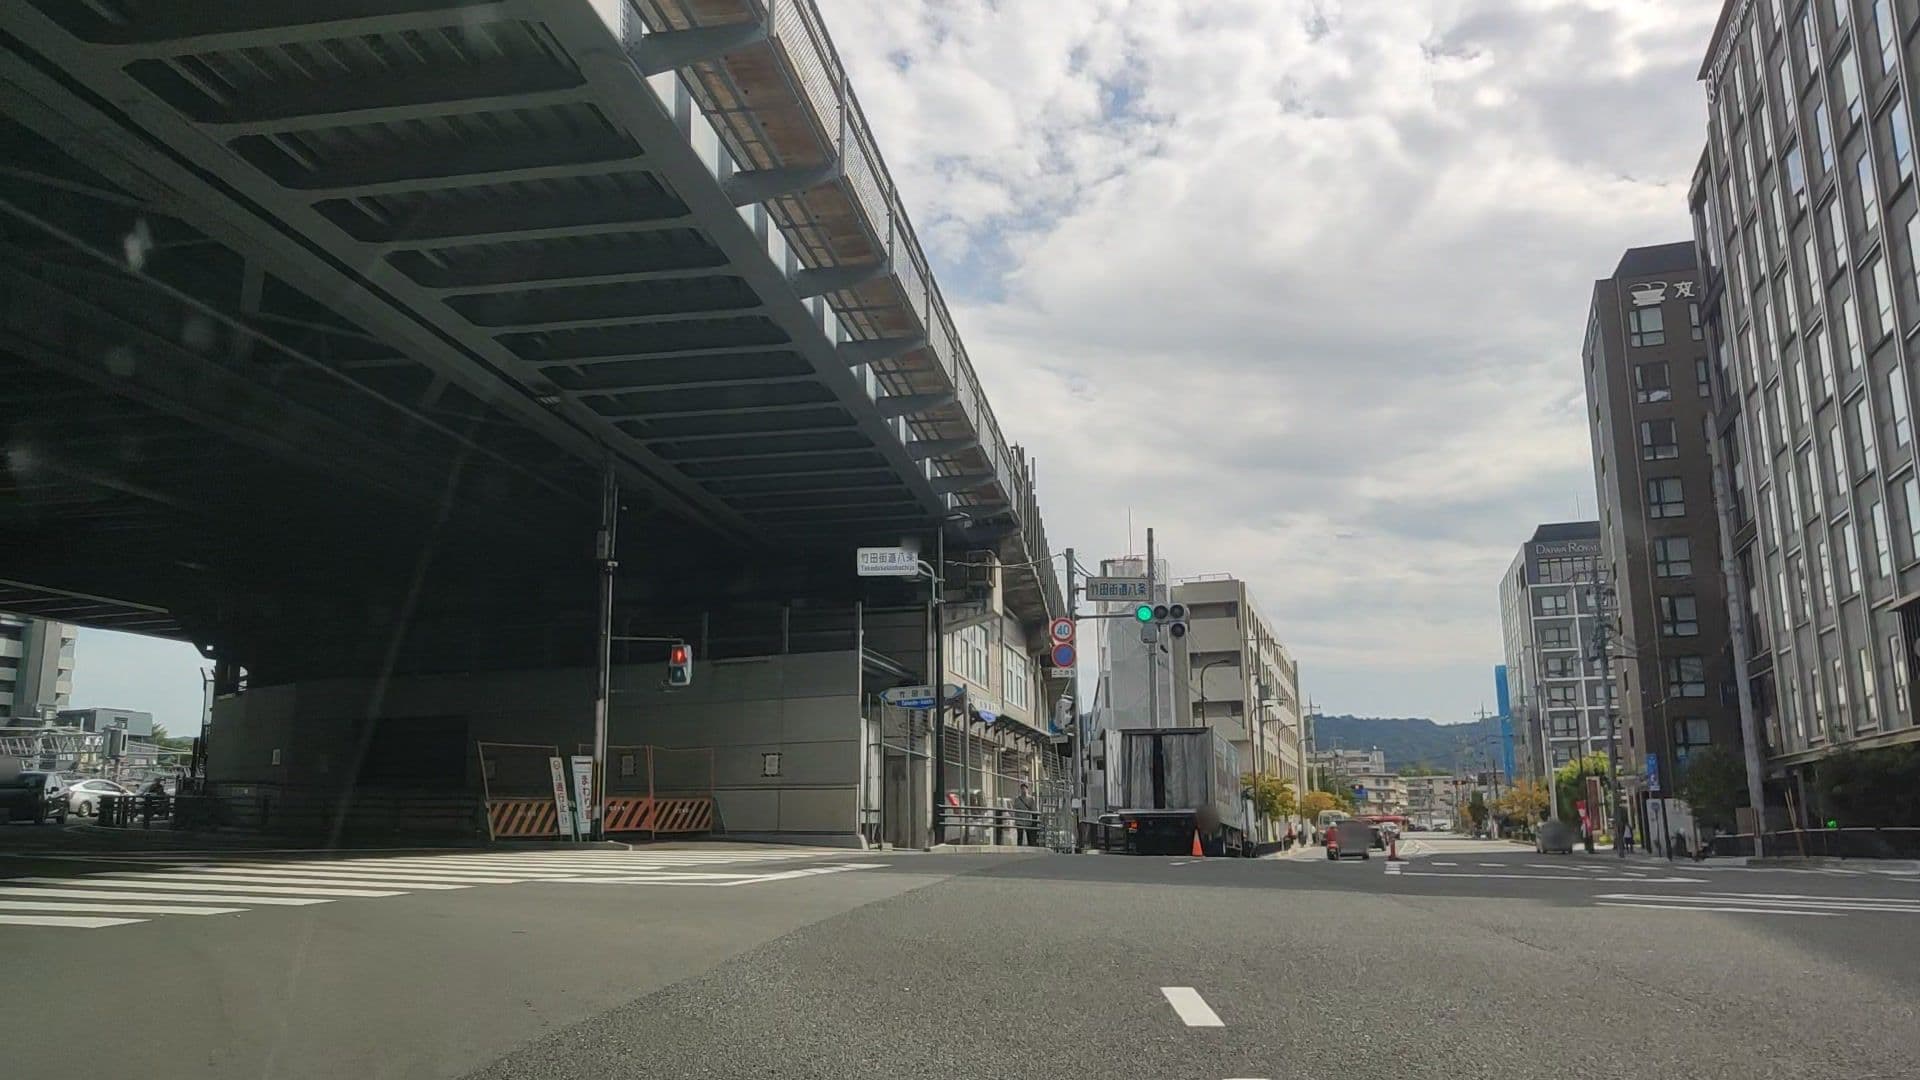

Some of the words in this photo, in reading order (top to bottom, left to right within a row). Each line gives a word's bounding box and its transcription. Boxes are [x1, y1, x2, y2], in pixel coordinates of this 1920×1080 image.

[1089, 582, 1148, 596] 竹田街道八条
[1056, 624, 1070, 636] 40
